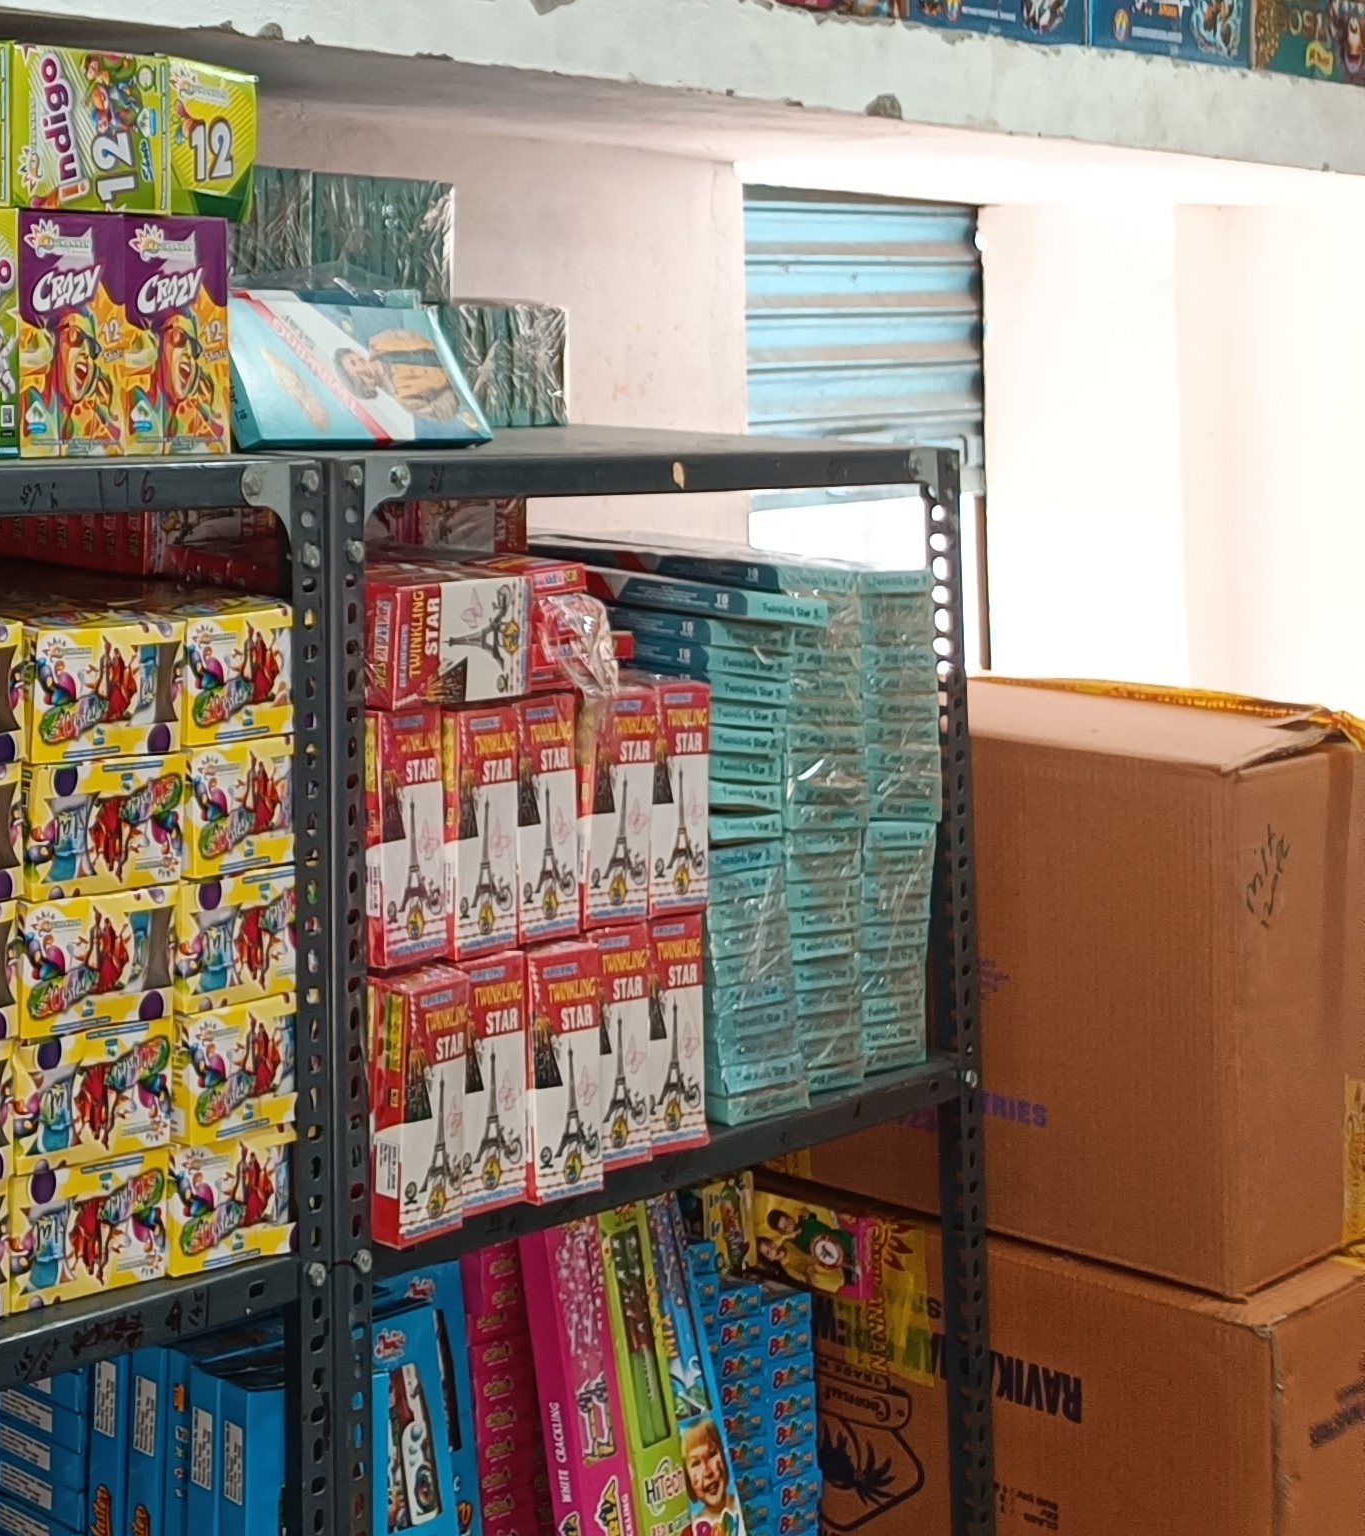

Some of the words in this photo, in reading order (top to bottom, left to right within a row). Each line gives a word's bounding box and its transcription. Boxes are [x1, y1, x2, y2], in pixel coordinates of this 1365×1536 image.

[190, 116, 234, 182] 12
[409, 590, 425, 679] TWINKLING
[425, 596, 441, 656] STAR
[674, 732, 702, 754] STAR
[474, 981, 522, 1008] TWINKLING
[486, 1008, 518, 1034] STAR
[561, 1004, 593, 1030] STAR
[549, 1402, 568, 1464] CRACKLING
